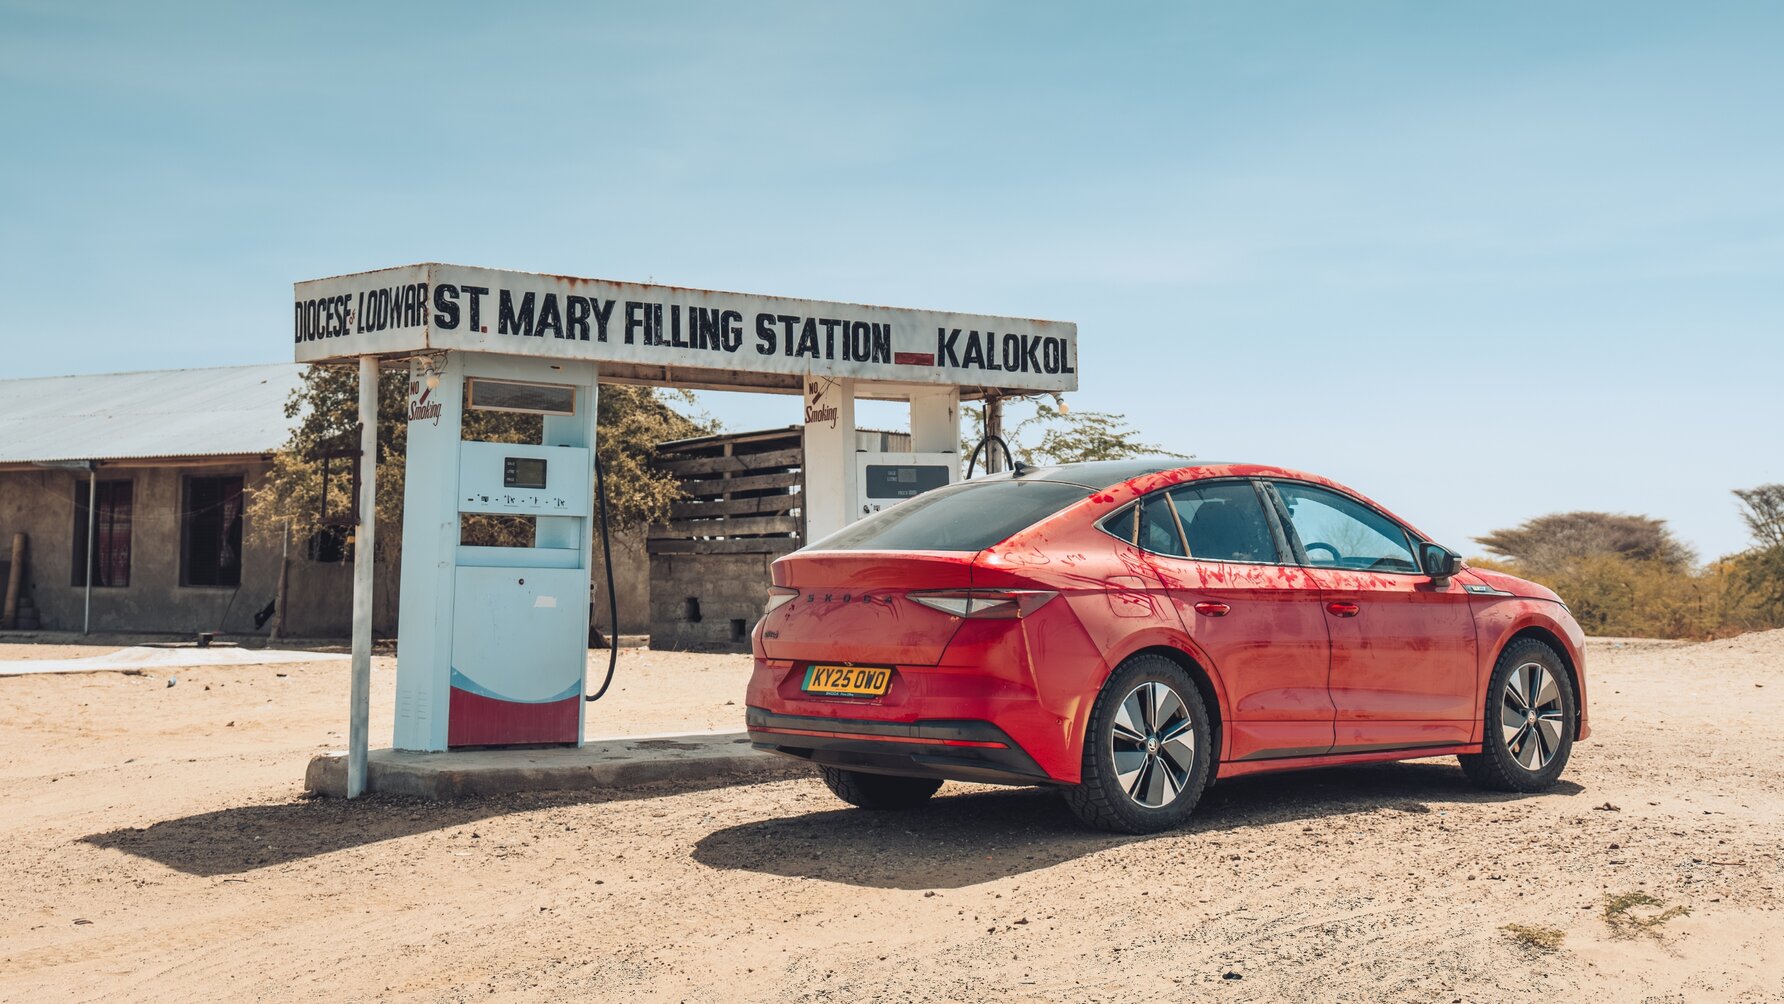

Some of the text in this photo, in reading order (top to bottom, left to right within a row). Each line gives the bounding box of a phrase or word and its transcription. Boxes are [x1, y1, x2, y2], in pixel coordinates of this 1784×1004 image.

[294, 293, 353, 344] DIOCESE
[356, 282, 429, 335] LODWAR
[433, 283, 1075, 375] ST. MARY FILLING STATION KALOKOL
[409, 380, 420, 396] NO
[808, 381, 819, 395] NO
[812, 667, 886, 690] KY25 OWO
